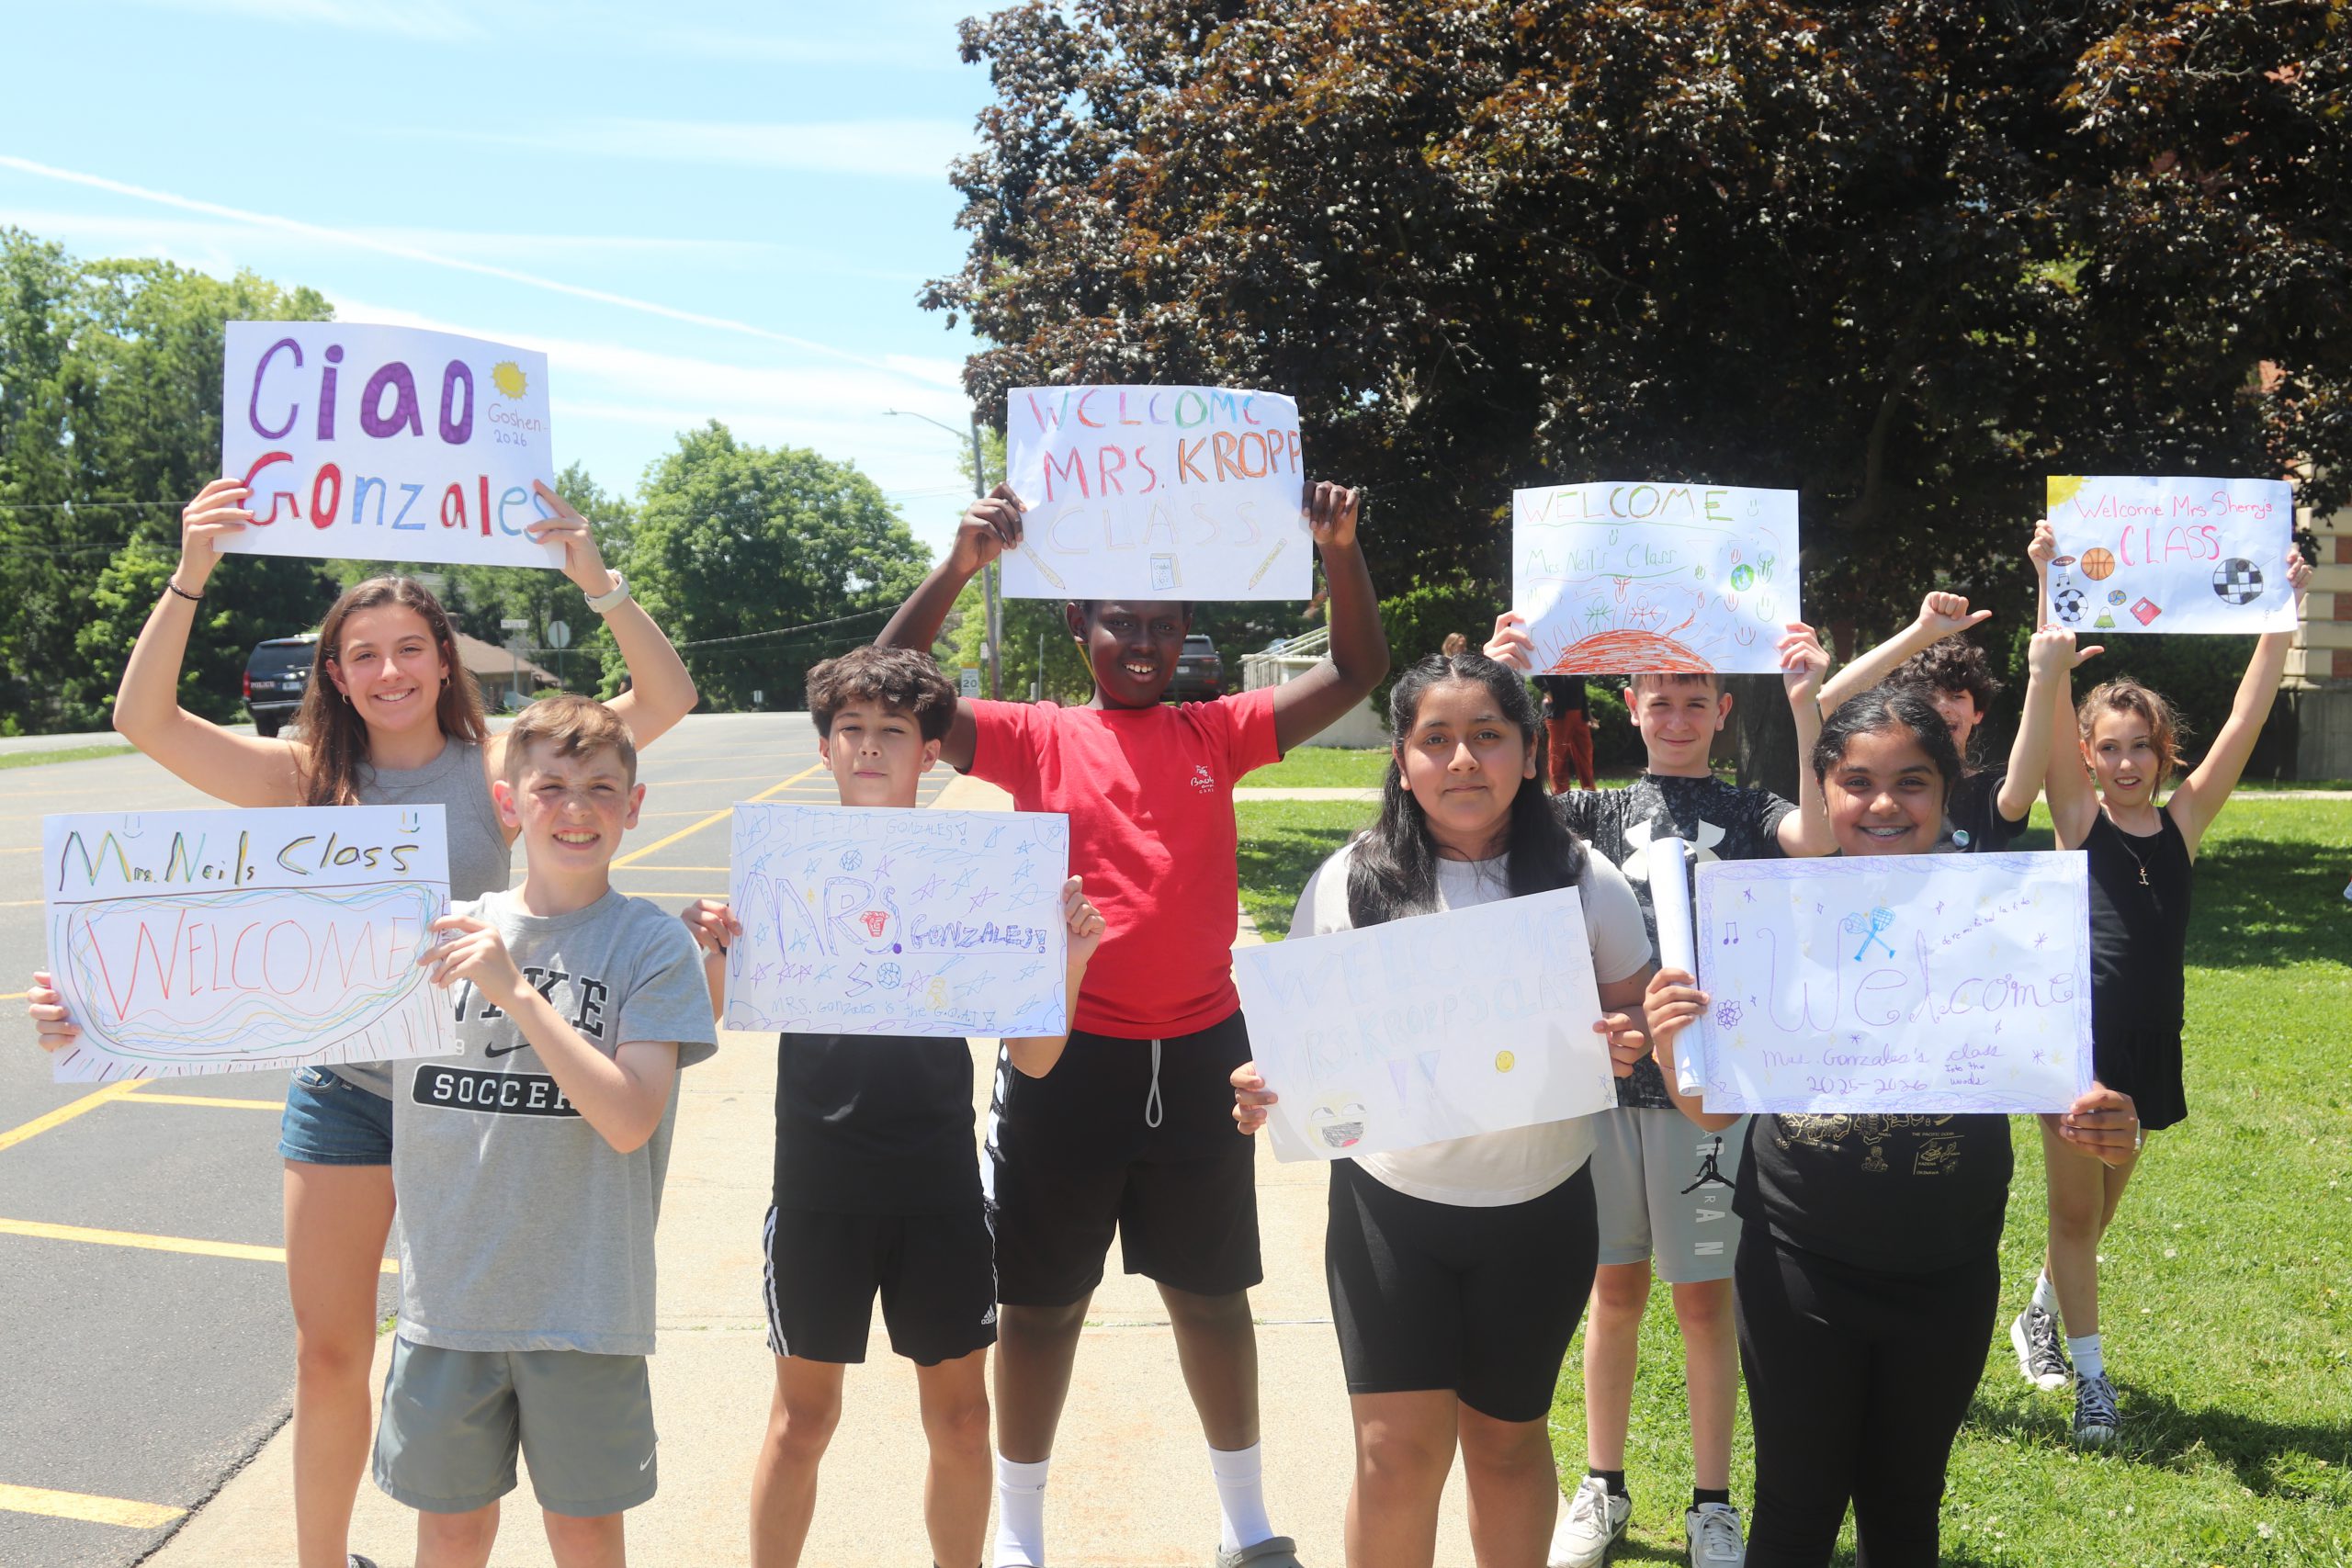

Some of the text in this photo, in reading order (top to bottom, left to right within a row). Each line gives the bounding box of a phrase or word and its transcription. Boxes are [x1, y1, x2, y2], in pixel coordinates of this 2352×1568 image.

[249, 337, 474, 445] Ciao
[493, 429, 527, 447] 2026
[1043, 429, 1302, 502] MRS. KROPP
[1520, 485, 1735, 522] WELCOME
[2073, 494, 2164, 519] Welcome
[2211, 491, 2273, 520] Sherry's
[1046, 500, 1261, 555] CLASS
[2120, 525, 2221, 567] CLASS
[1625, 543, 1677, 569] Class
[250, 681, 275, 689] POLICE
[962, 679, 978, 688] 20
[277, 831, 420, 875] Class
[85, 908, 419, 1021] WELCOME
[1757, 919, 2074, 1032] Welcome
[1946, 1043, 2007, 1062] class
